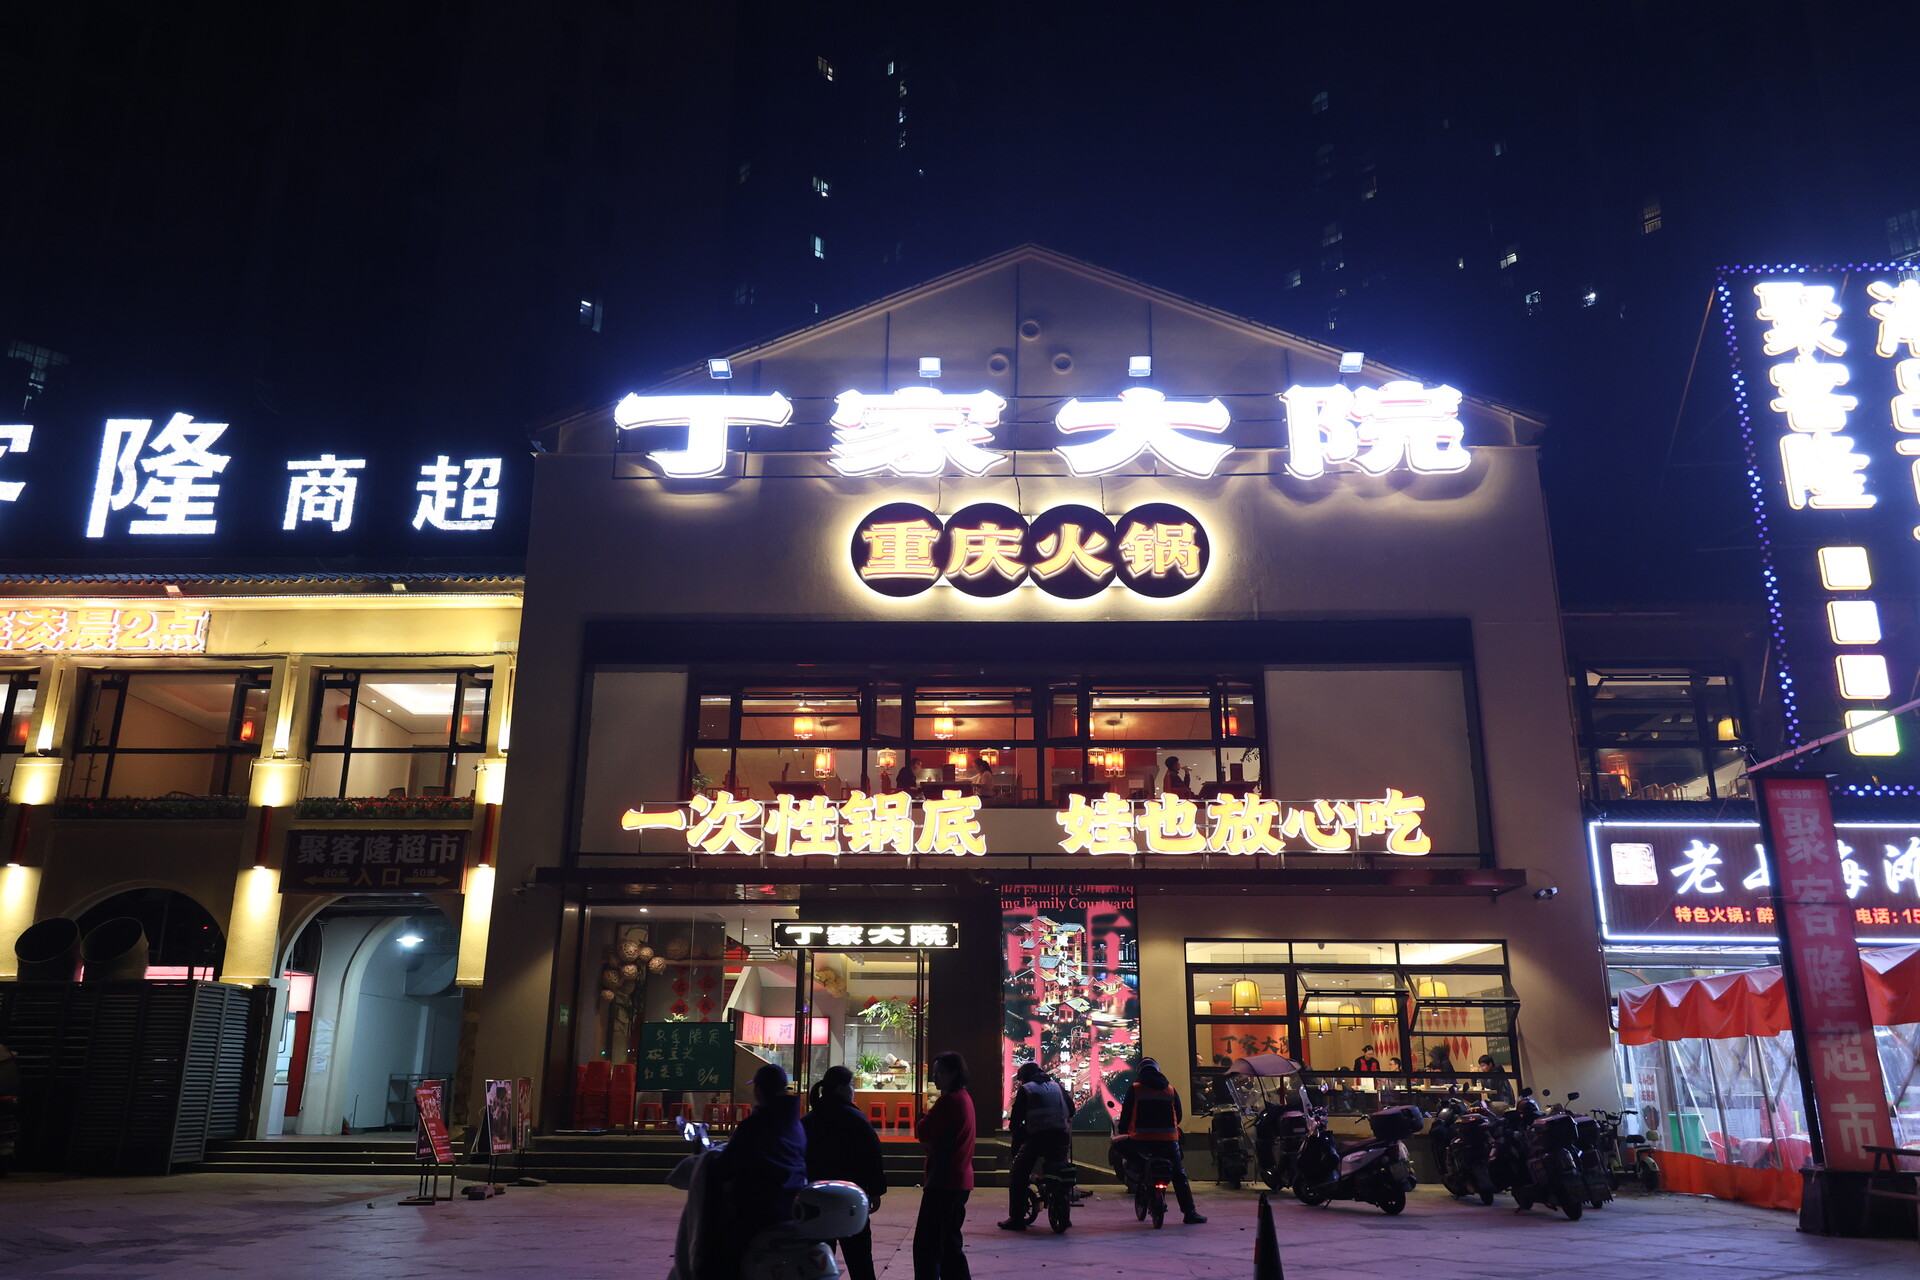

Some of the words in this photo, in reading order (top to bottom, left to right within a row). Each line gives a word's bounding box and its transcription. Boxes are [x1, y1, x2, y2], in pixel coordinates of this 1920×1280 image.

[614, 380, 1472, 480] 丁家大院
[859, 521, 1200, 583] 重庆火锅
[620, 789, 987, 858] 一次性锅底
[1056, 787, 1432, 858] 娃也放心吃
[297, 834, 460, 865] 聚客隆超市
[323, 868, 347, 879] 80米
[353, 867, 401, 887] 入口
[412, 868, 436, 879] 50米
[1023, 896, 1066, 912] Family
[785, 924, 948, 946] 丁家大院
[1777, 806, 1879, 1160] 聚客隆超市
